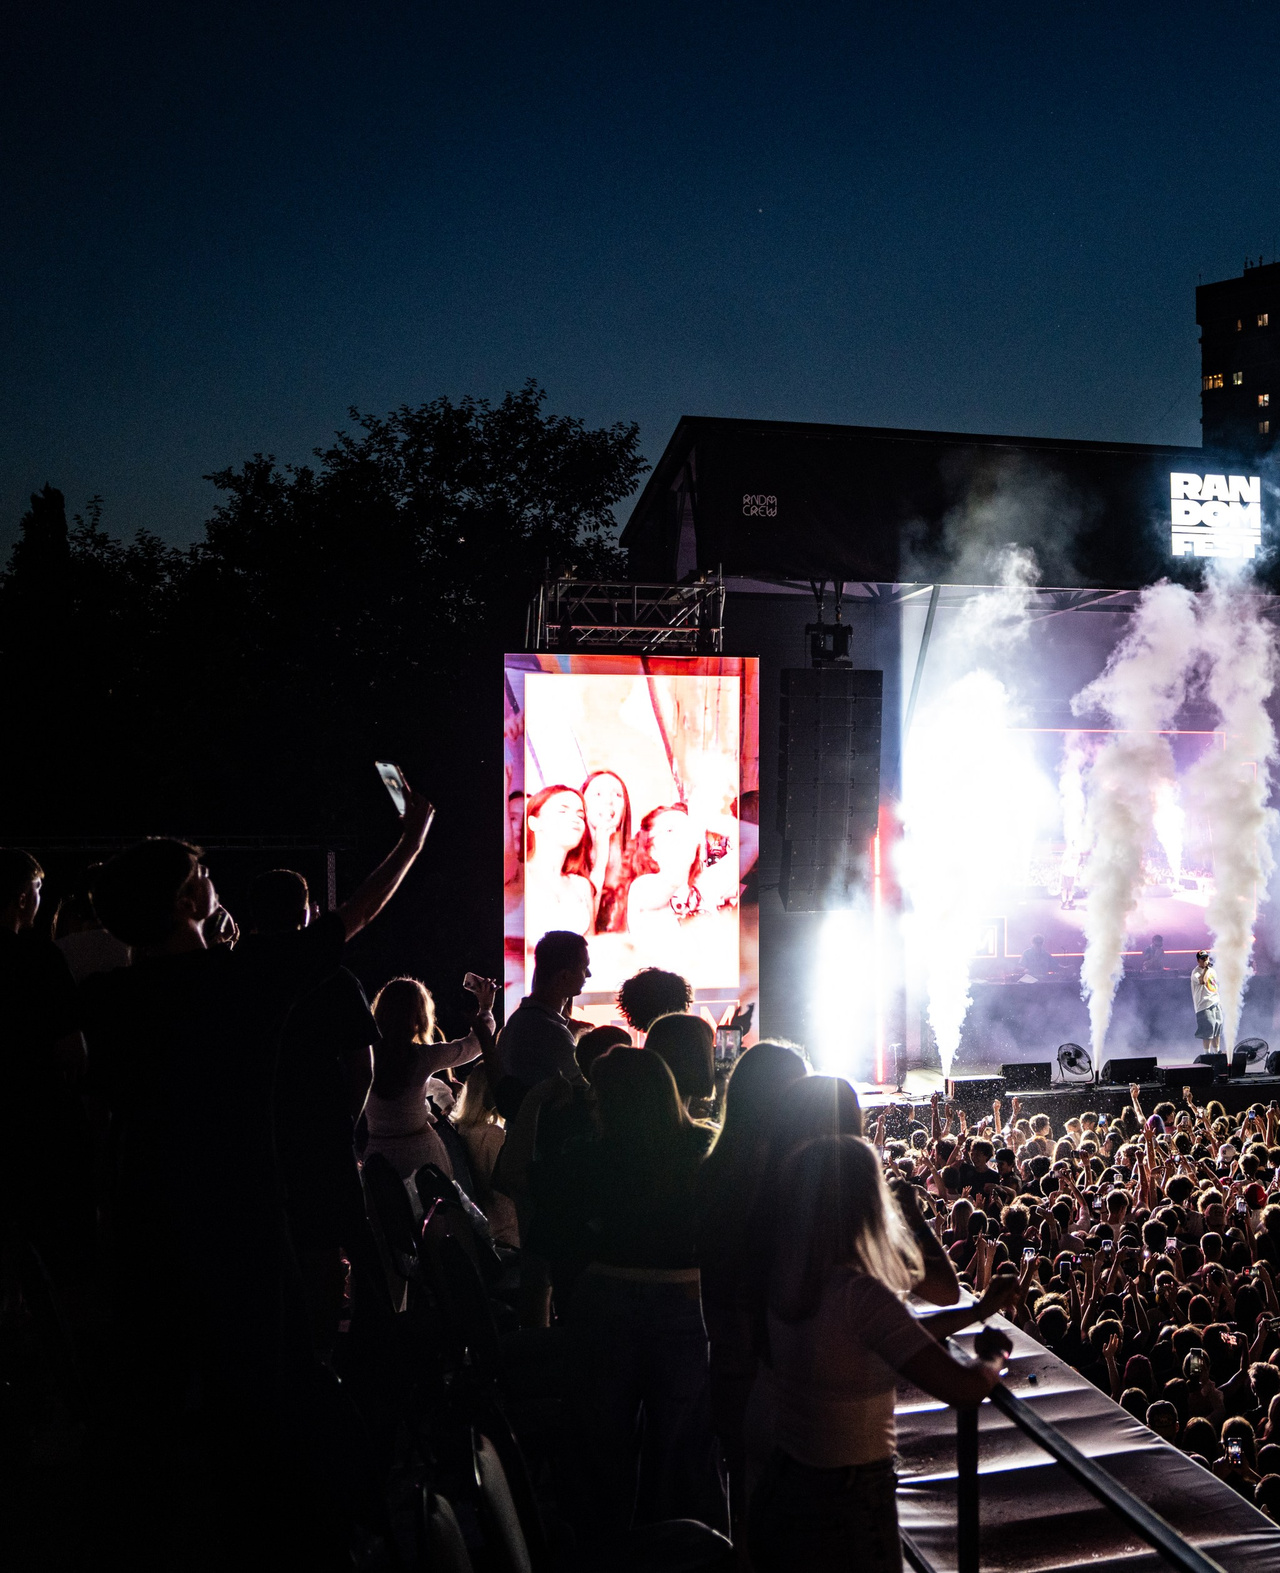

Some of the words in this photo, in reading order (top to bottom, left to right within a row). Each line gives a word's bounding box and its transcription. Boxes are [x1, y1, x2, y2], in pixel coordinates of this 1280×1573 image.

[1170, 472, 1261, 503] RAN
[743, 505, 777, 517] CREW
[1171, 499, 1262, 529] DOM
